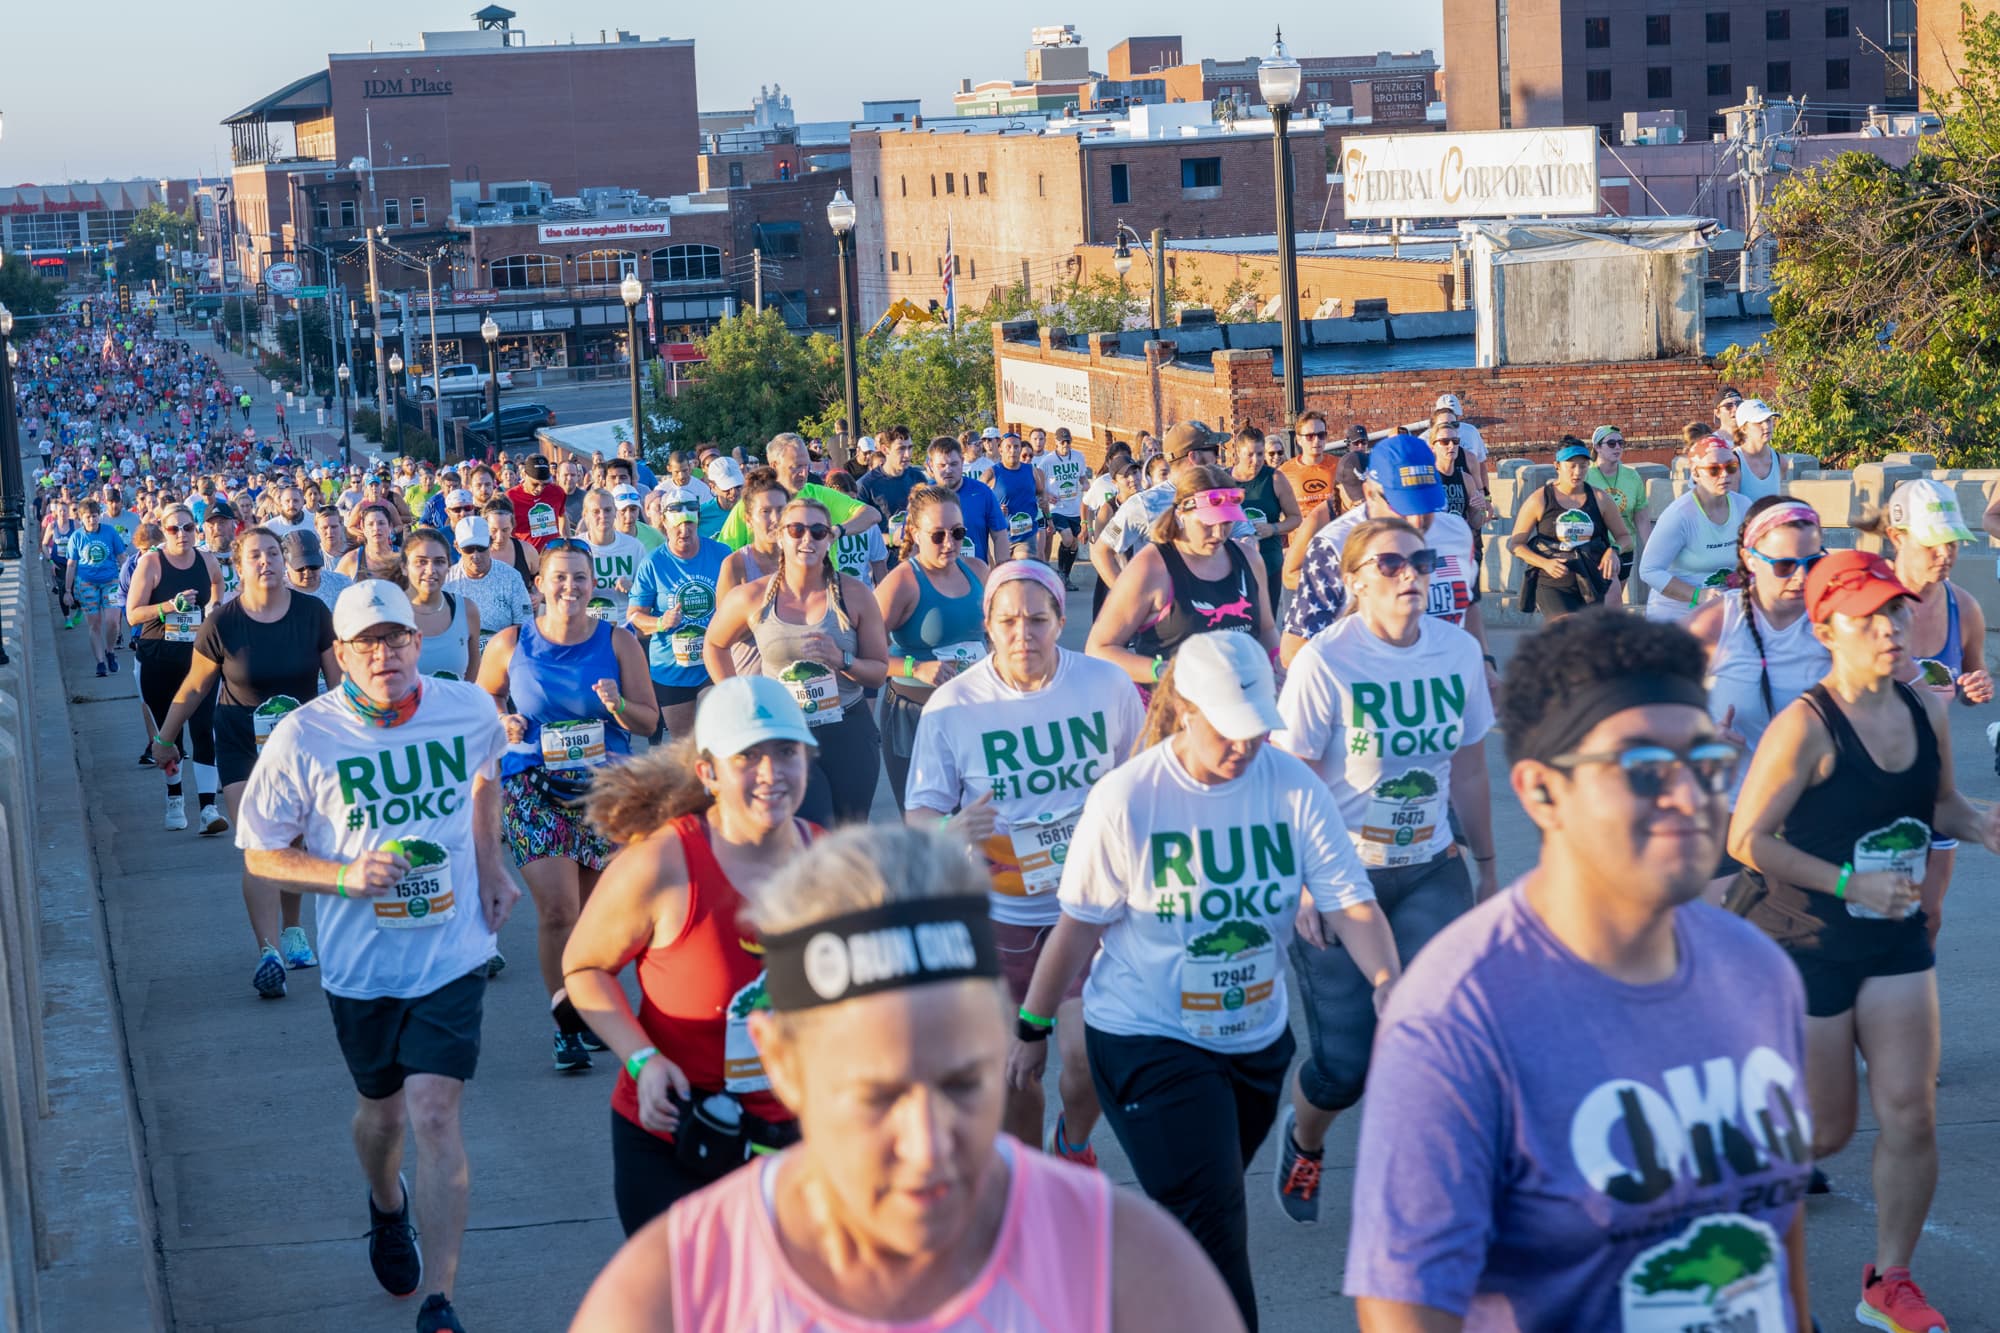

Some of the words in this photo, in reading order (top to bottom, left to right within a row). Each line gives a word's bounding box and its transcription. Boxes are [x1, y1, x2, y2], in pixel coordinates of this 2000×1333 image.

[363, 79, 404, 98] JDM
[411, 77, 454, 93] Place
[1374, 82, 1422, 93] HUNZICKER
[1374, 92, 1423, 103] BROTHERS
[216, 187, 228, 201] 7
[545, 227, 562, 238] the
[564, 226, 580, 236] old
[581, 223, 627, 236] spaghetti
[629, 221, 665, 233] factory
[1055, 380, 1089, 405] AVAILABLE
[1038, 388, 1055, 417] Group
[1053, 463, 1080, 475] RUN
[838, 533, 868, 552] UN
[595, 555, 632, 576] UN
[838, 552, 865, 564] OKC
[796, 687, 824, 700] 16800
[1352, 674, 1465, 728] RUN
[560, 734, 590, 747] 13180
[981, 711, 1108, 776] RUN
[337, 736, 467, 805] RUN
[1391, 810, 1425, 825] 16473
[1151, 822, 1296, 888] RUN
[394, 878, 440, 898] 15335
[1211, 964, 1257, 989] 12942
